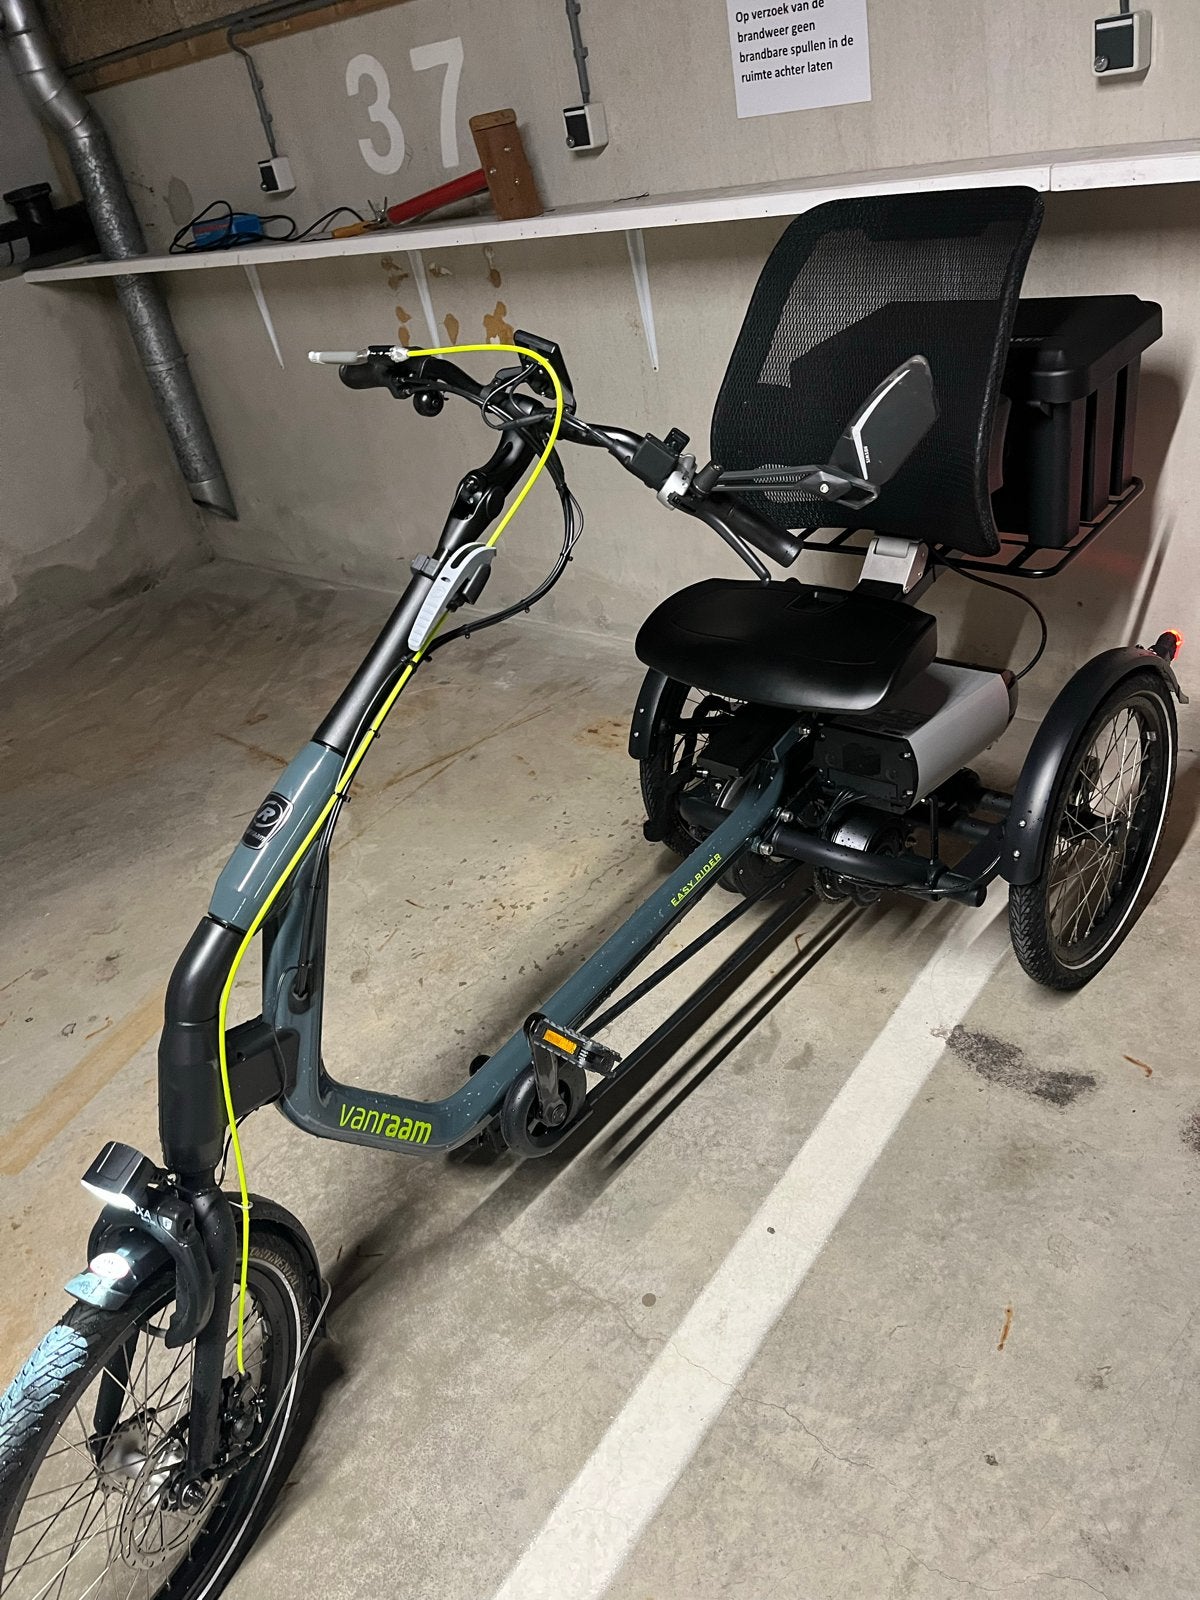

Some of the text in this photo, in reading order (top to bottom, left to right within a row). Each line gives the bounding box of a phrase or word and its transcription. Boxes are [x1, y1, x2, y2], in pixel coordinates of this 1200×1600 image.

[735, 0, 825, 24] Op verzoek van de
[737, 21, 816, 43] brandweer geen
[739, 34, 854, 63] brandbare spullen in de
[741, 60, 833, 83] ruimte achter laten
[346, 37, 464, 175] 37
[670, 853, 722, 907] EASY RIDER
[339, 1103, 433, 1145] vanraam
